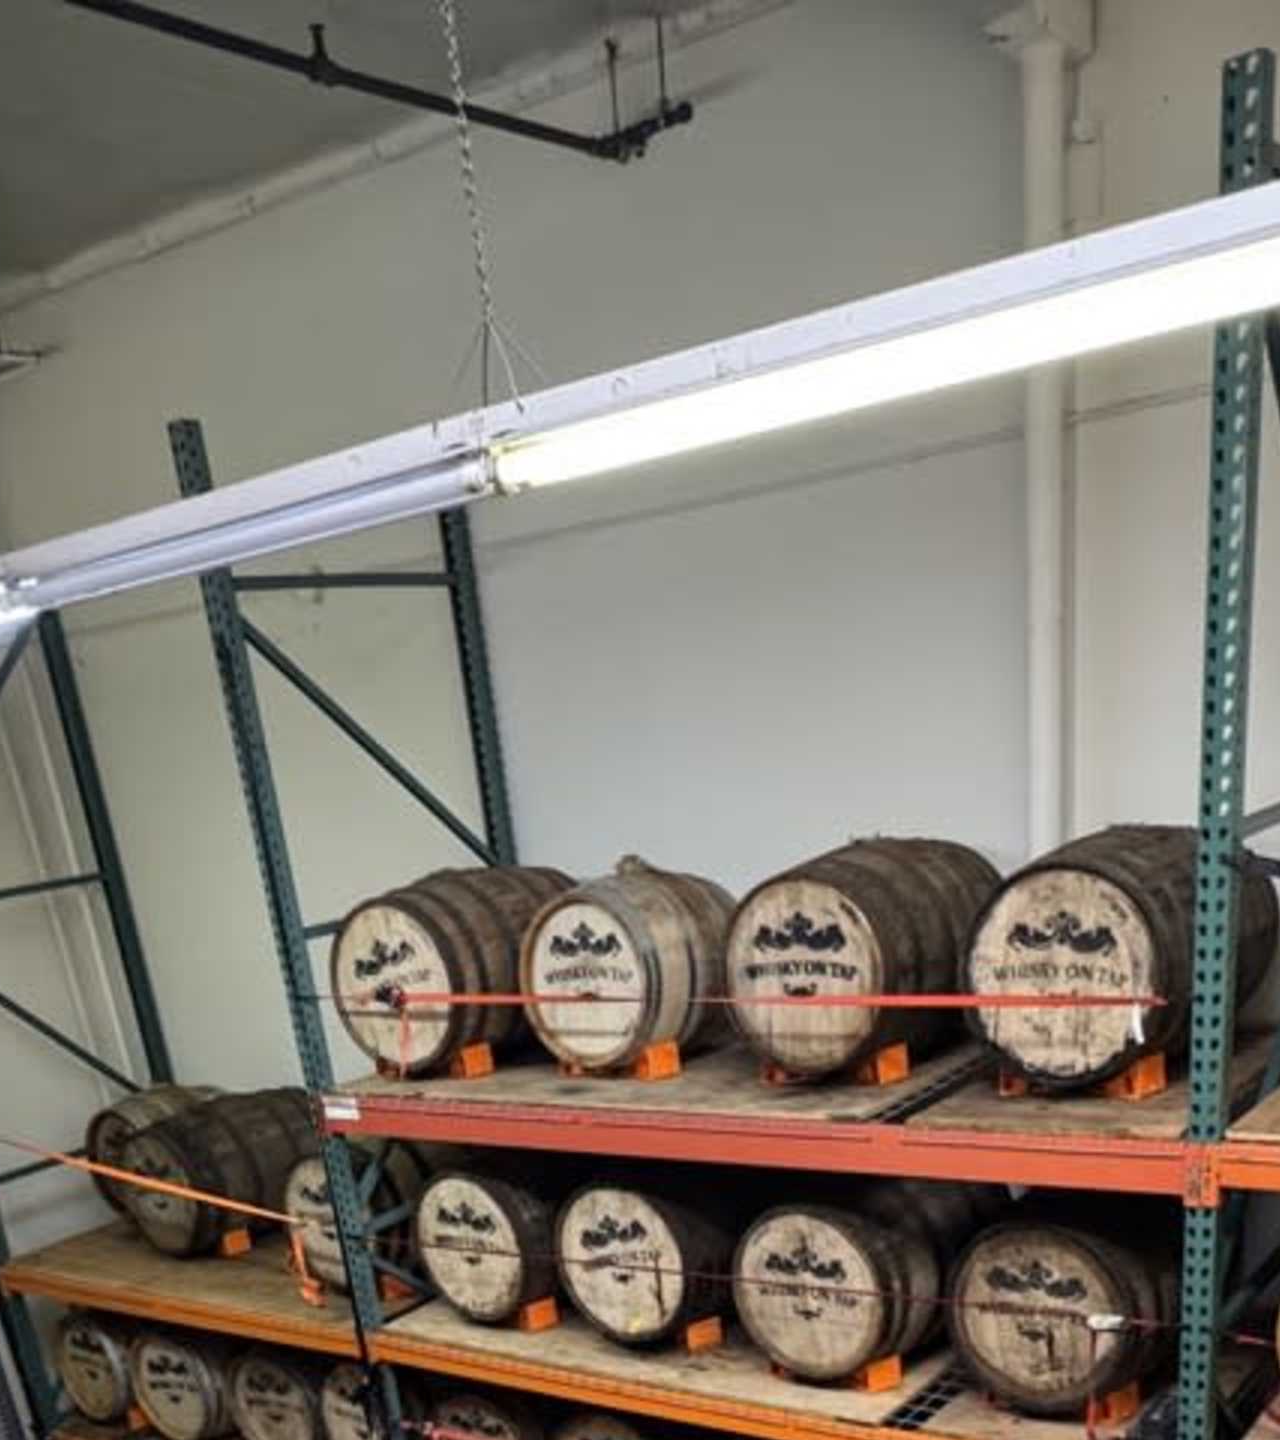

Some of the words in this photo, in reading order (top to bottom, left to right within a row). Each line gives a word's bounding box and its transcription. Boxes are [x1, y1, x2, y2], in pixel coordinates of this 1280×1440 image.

[803, 960, 826, 976] ON
[831, 963, 857, 981] TAP
[993, 963, 1059, 981] WHISKY
[1064, 964, 1093, 981] ON
[1096, 967, 1129, 988] TAP
